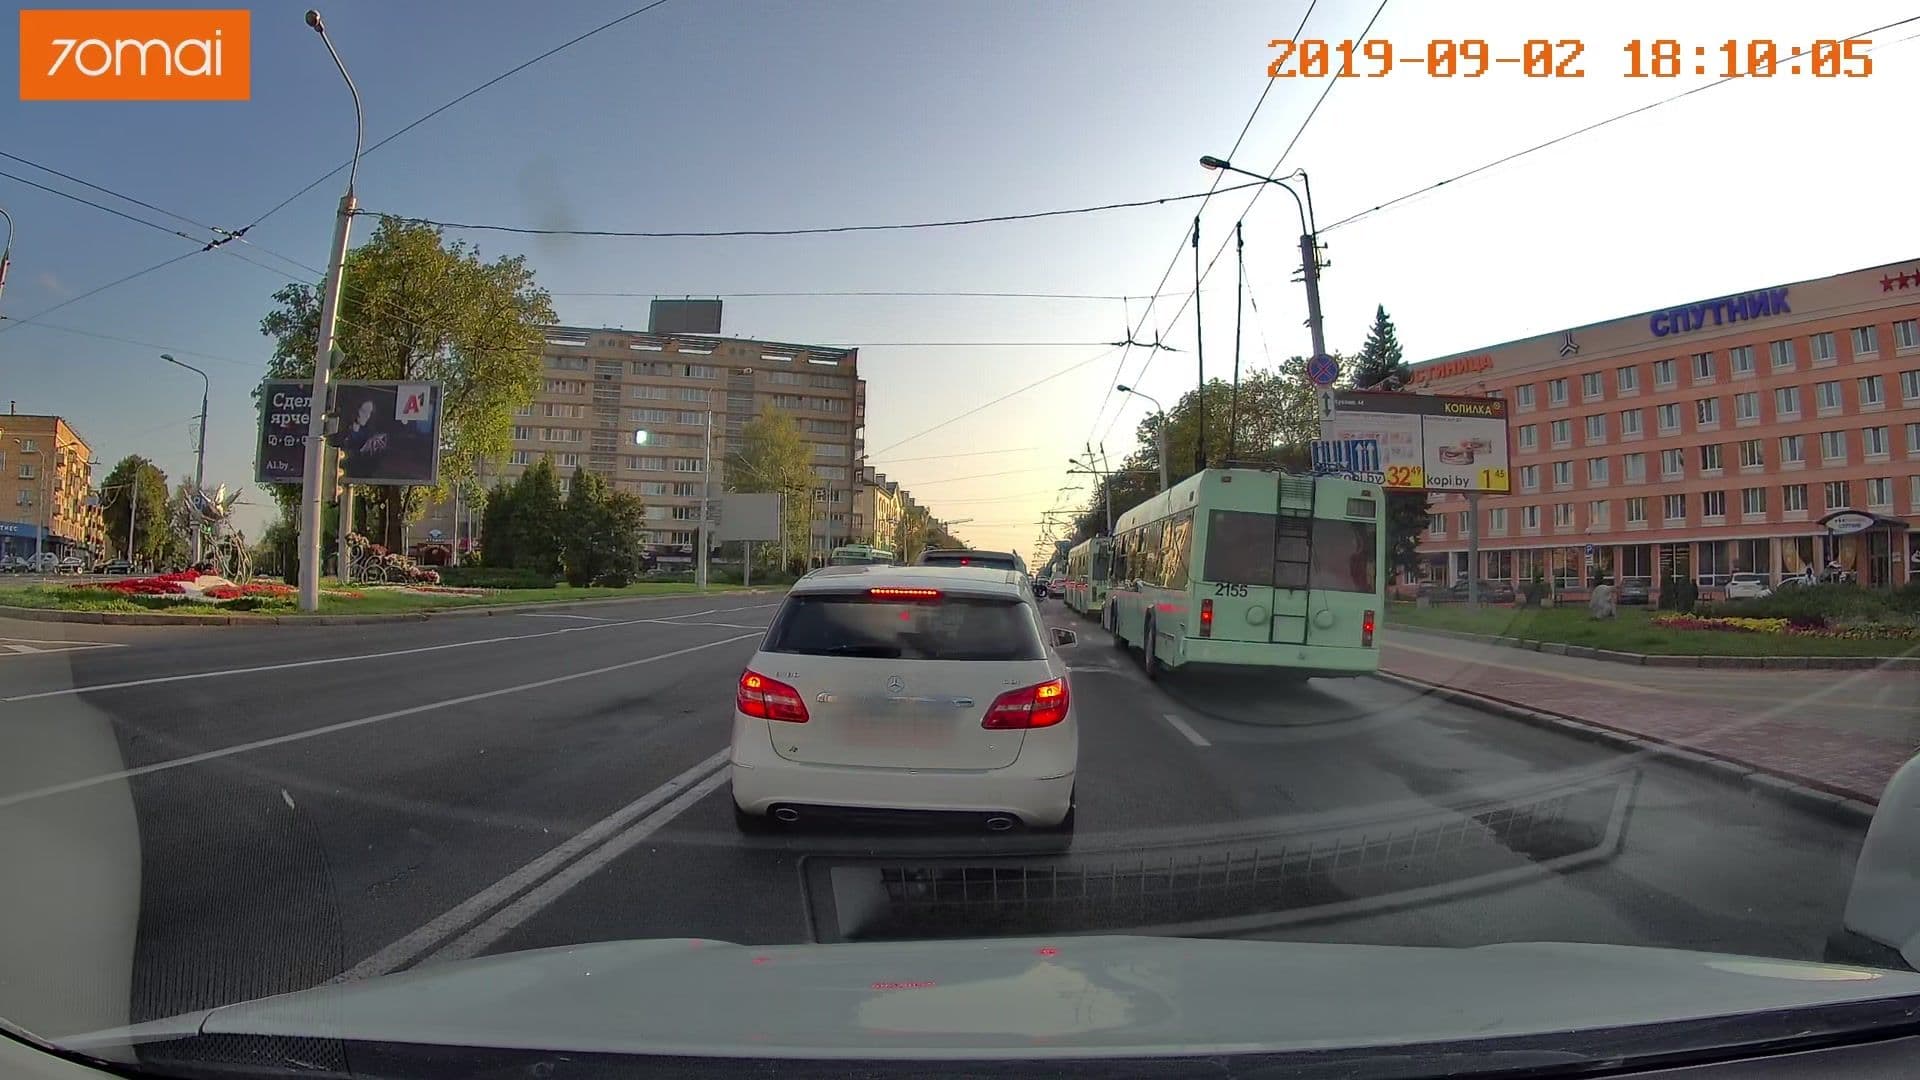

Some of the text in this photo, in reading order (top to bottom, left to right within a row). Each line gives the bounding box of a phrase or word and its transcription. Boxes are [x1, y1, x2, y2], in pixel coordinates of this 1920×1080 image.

[1650, 288, 1792, 337] СПУТНИК
[1408, 352, 1494, 385] СТИНИЦА
[1444, 403, 1492, 415] КОПИЛКА
[270, 413, 310, 428] ярче
[1215, 582, 1248, 598] 2155
